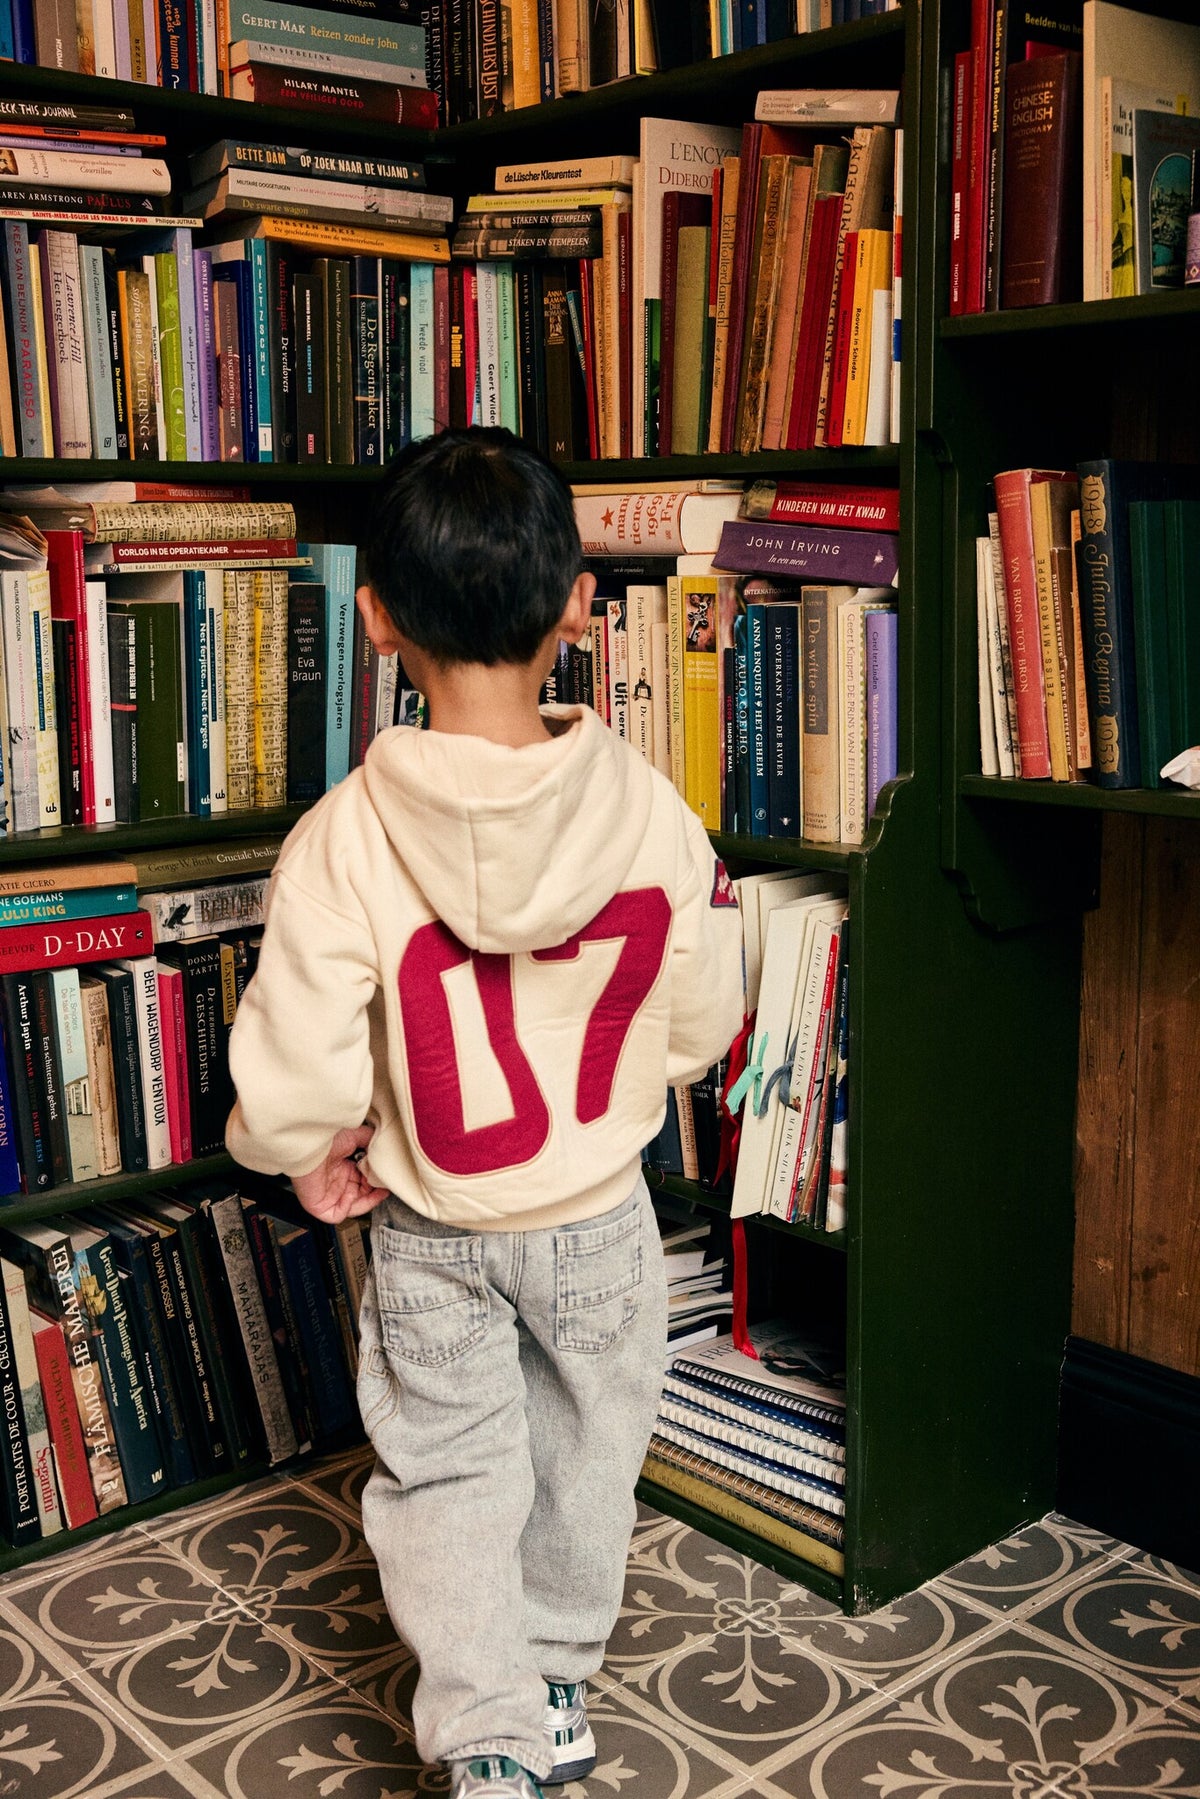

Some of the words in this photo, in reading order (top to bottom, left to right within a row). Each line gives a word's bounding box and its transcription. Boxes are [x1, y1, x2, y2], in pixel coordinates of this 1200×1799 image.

[242, 13, 277, 29] GEERT
[280, 19, 306, 35] MAK
[310, 25, 341, 41] Reizen
[344, 33, 375, 47] zonder
[377, 36, 399, 50] John
[996, 10, 1004, 48] Beelden
[257, 44, 276, 53] JAN
[279, 48, 332, 62] SIEBELINK
[284, 78, 318, 91] HILARY
[321, 84, 360, 98] MANTEL
[992, 87, 1000, 133] Rozekruis
[1012, 107, 1053, 126] ENGLISH
[236, 147, 264, 163] BETTE
[265, 150, 286, 166] DAM
[300, 154, 312, 168] OP
[313, 155, 335, 172] ZOEK
[337, 159, 363, 175] NAAR
[364, 163, 375, 176] DE
[376, 164, 409, 180] VIJAND
[505, 172, 513, 184] de
[514, 170, 540, 183] Lüscher
[541, 167, 582, 182] Kleurentest
[242, 199, 254, 210] De
[256, 203, 283, 214] zwarte
[285, 206, 309, 217] wagon
[512, 214, 538, 225] STAKEN
[539, 214, 549, 224] EN
[551, 213, 592, 224] STEMPELEN
[13, 225, 22, 254] KEES
[273, 219, 320, 232] KIRSTEN
[323, 226, 356, 236] BAKIS
[508, 236, 535, 248] STAKEN
[536, 236, 548, 247] EN
[548, 236, 590, 247] STEMPELEN
[14, 257, 24, 281] VAN
[53, 271, 62, 295] Het
[279, 258, 287, 288] Anna
[17, 283, 28, 333] BEIJNUM
[64, 272, 77, 333] Lawrence
[483, 271, 493, 314] MEINDERT
[257, 255, 266, 376] NIETZSCHE
[367, 318, 378, 339] De
[852, 308, 862, 335] Roovers
[54, 300, 68, 364] negerboek
[112, 330, 120, 361] Aarsman
[281, 337, 289, 351] De
[486, 317, 495, 358] FENNEMA
[852, 338, 860, 346] in
[70, 337, 82, 364] Hill
[851, 347, 859, 381] Schiedam
[20, 339, 35, 419] PARADISO
[115, 368, 121, 377] De
[282, 352, 291, 393] verdovers
[364, 342, 378, 429] Regenmaker
[115, 378, 124, 422] fotodetective
[489, 394, 497, 427] Wilder
[647, 495, 663, 538] 1969
[776, 499, 817, 514] KINDEREN
[819, 501, 836, 515] VAN
[837, 503, 854, 517] HET
[856, 504, 886, 520] KWAAD
[1083, 476, 1102, 530] 1948
[119, 547, 149, 557] OORLOG
[150, 547, 157, 556] IN
[158, 547, 169, 556] DE
[169, 546, 229, 556] OPERATIEKAMER
[746, 535, 784, 550] JOHN
[789, 539, 841, 556] IRVING
[768, 554, 776, 562] In
[777, 556, 788, 564] een
[789, 557, 808, 566] mens
[1011, 555, 1021, 583] VAN
[670, 587, 678, 609] ALLE
[1084, 543, 1111, 628] Juliana
[300, 617, 312, 625] Het
[637, 596, 646, 620] Frank
[1012, 588, 1024, 622] BRON
[293, 626, 319, 635] verloren
[297, 636, 315, 644] leven
[338, 603, 348, 661] Verzwegen
[638, 623, 646, 661] McCourt
[671, 611, 679, 653] MENSEN
[753, 618, 762, 649] ANNA
[775, 626, 782, 640] DE
[808, 618, 820, 646] De
[847, 613, 855, 643] Geert
[1016, 627, 1027, 653] TOT
[292, 670, 321, 681] Braun
[297, 657, 315, 668] Eva
[671, 655, 680, 677] ZIJN
[738, 654, 748, 697] PAULO
[754, 650, 762, 698] ENQUIST
[775, 643, 783, 698] OVERKANT
[808, 649, 819, 691] witte
[845, 646, 856, 681] Kimpen
[1018, 658, 1029, 693] BRON
[1093, 631, 1115, 709] Regina
[336, 663, 347, 730] oorlogsjaren
[672, 678, 681, 723] ONGELIJK
[847, 684, 855, 698] DE
[641, 706, 647, 717] De
[805, 694, 817, 728] spin
[847, 700, 855, 730] PRINS
[739, 701, 748, 754] COELHO
[776, 725, 783, 739] DE
[848, 732, 856, 754] VAN
[1099, 718, 1116, 765] 1953
[776, 741, 784, 777] RIVIER
[848, 757, 856, 816] FILETTINO
[187, 953, 220, 966] DONNA
[190, 963, 219, 976] TARTT
[144, 970, 156, 999] BERT
[207, 986, 216, 1002] De
[224, 961, 235, 1020] Expeditie
[807, 974, 819, 1006] JOHN
[147, 1003, 162, 1072] WAGENDORP
[196, 993, 209, 1094] GESCHIEDENIS
[209, 1005, 217, 1057] VERBORGEN
[398, 886, 672, 1176] 07
[152, 1076, 166, 1126] VENTOUX
[98, 1246, 116, 1278] Great
[151, 1241, 162, 1256] RU
[153, 1258, 166, 1278] VAN
[50, 1244, 85, 1336] MALEREI
[104, 1280, 126, 1311] Dutch
[158, 1278, 174, 1320] ROSSEM
[111, 1311, 135, 1359] Paintings
[237, 1282, 269, 1385] MAHARAJAS
[121, 1360, 140, 1385] from
[74, 1341, 112, 1457] FLÄMISCHE
[128, 1385, 150, 1431] America
[34, 1447, 58, 1513] Segantini
